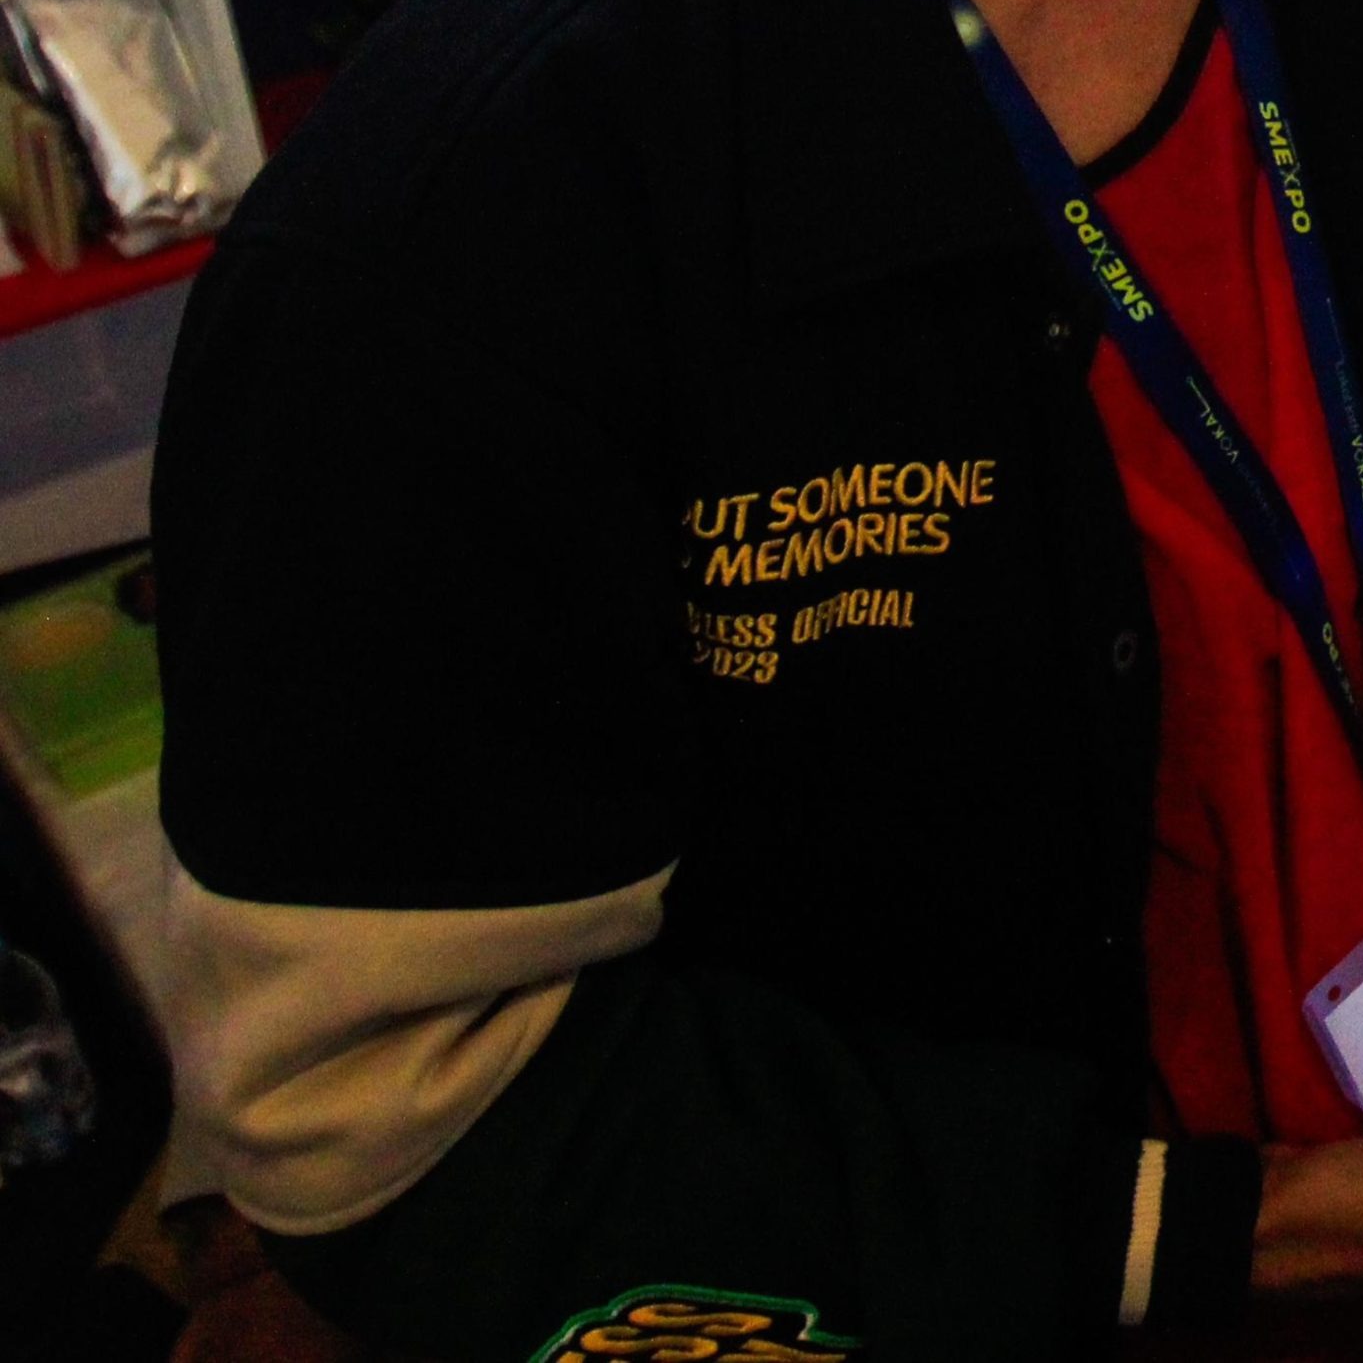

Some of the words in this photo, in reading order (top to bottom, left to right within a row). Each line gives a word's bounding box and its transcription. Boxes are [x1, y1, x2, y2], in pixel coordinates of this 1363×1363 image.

[1259, 101, 1312, 234] SMEXPO
[1064, 199, 1154, 322] SMEXPO
[685, 492, 760, 541] UT
[768, 460, 996, 532] SOMEONE
[705, 512, 950, 587] MEMORIES
